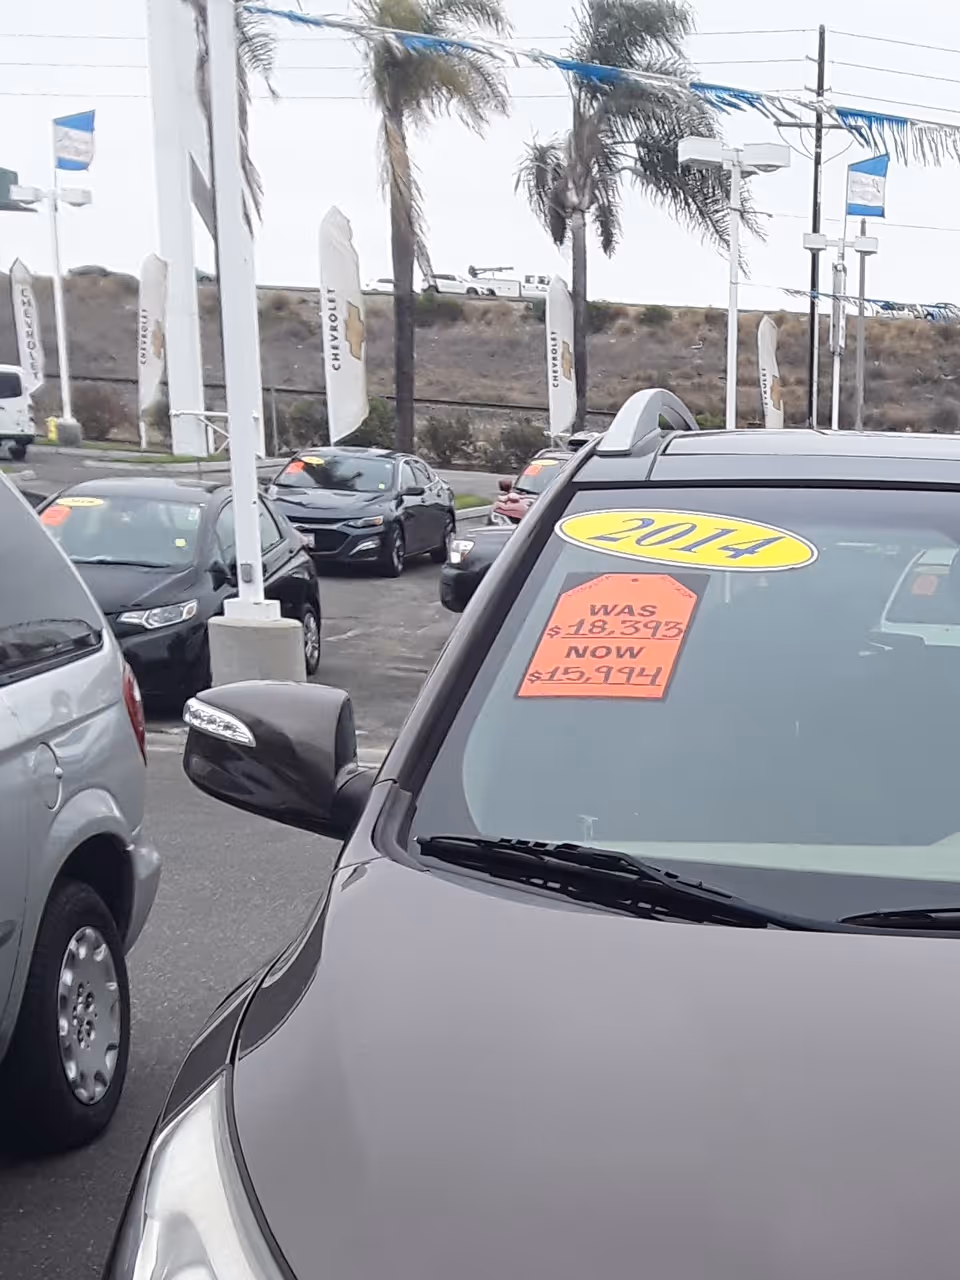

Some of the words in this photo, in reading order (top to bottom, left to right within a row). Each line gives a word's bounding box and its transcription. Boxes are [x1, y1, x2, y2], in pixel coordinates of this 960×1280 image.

[21, 288, 39, 380] CHEVROLET
[327, 287, 341, 371] CHEVROLET
[550, 331, 559, 388] CHEVROLET
[586, 518, 786, 559] 2014
[547, 618, 684, 638] $18,393
[589, 604, 658, 617] WAS
[565, 645, 645, 660] NOW
